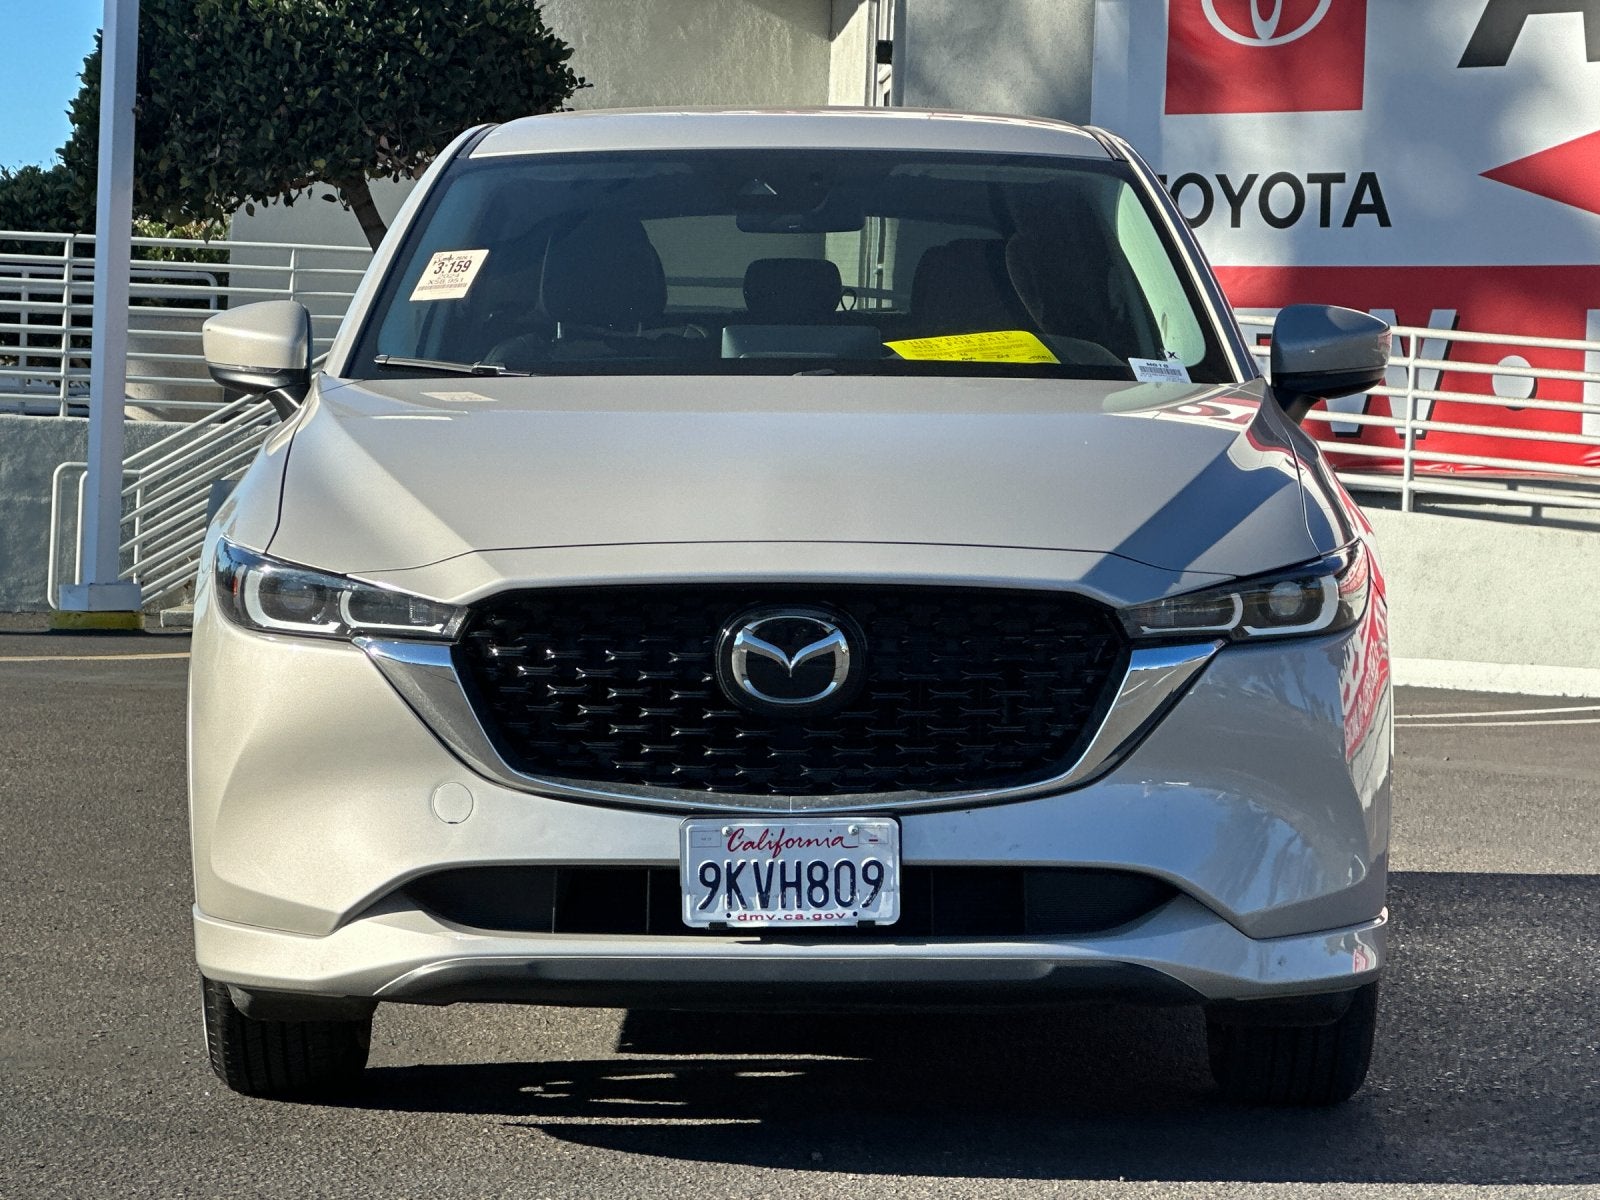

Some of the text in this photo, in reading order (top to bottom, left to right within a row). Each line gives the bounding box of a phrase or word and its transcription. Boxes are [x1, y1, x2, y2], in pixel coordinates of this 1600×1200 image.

[1158, 172, 1392, 229] OYOTA
[727, 828, 858, 858] California
[698, 860, 885, 910] 9KVH809
[737, 911, 847, 922] dmv.ca.gov
